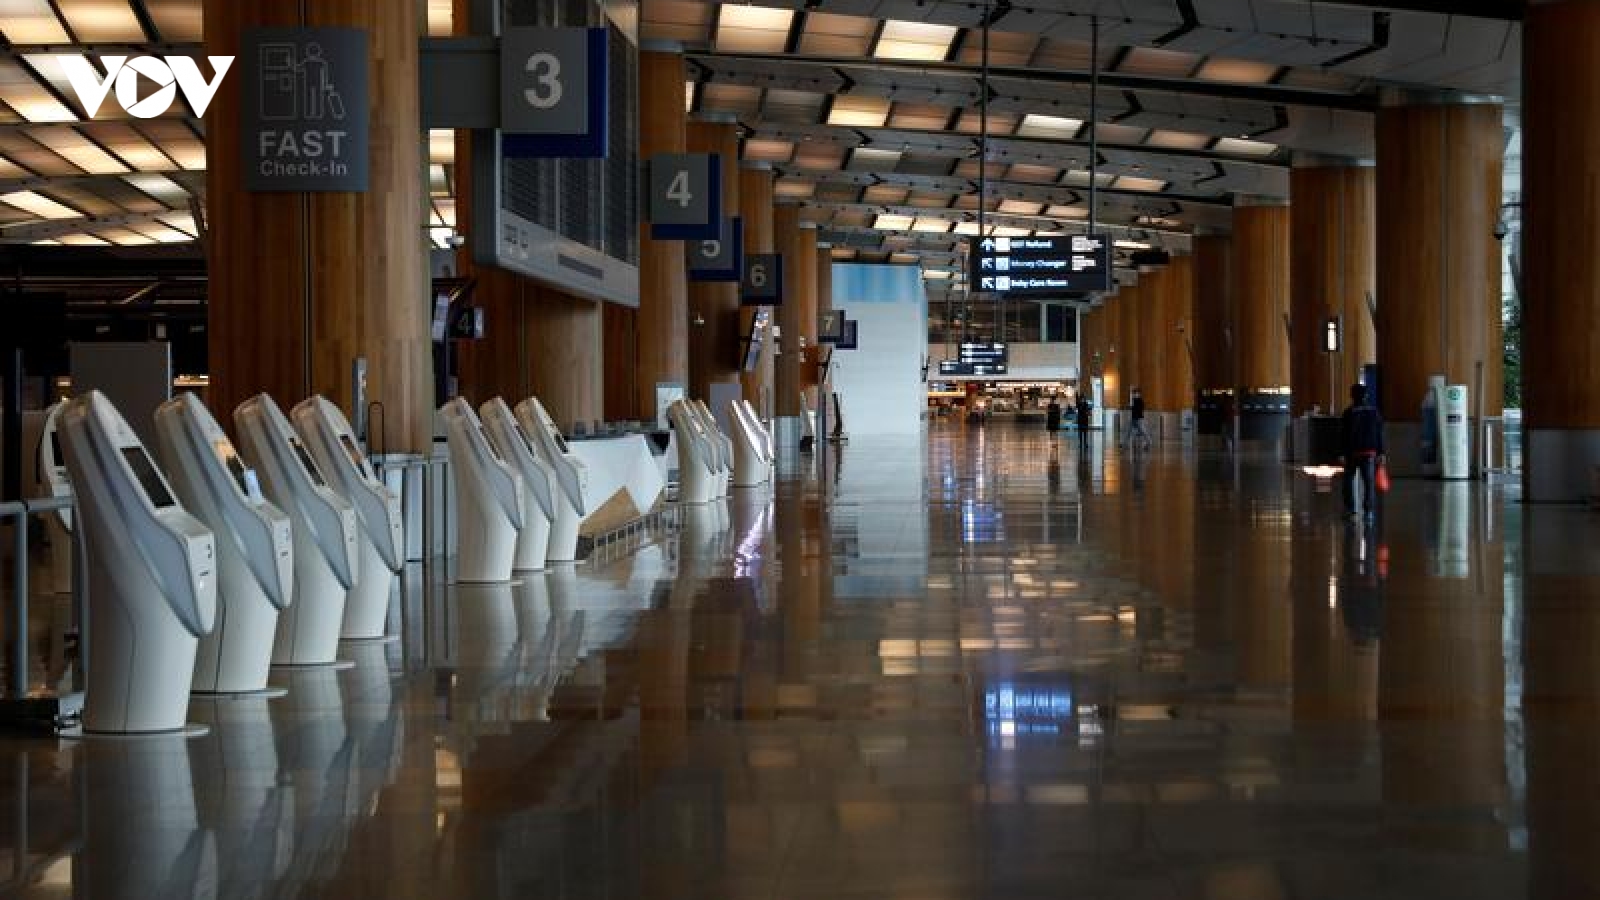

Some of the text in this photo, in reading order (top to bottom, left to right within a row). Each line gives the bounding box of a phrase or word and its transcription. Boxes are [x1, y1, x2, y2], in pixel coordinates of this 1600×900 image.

[524, 53, 563, 108] 3
[259, 131, 347, 157] FAST
[260, 160, 348, 176] Check-In
[666, 171, 692, 207] 4
[751, 264, 766, 287] 6
[823, 315, 835, 332] 7
